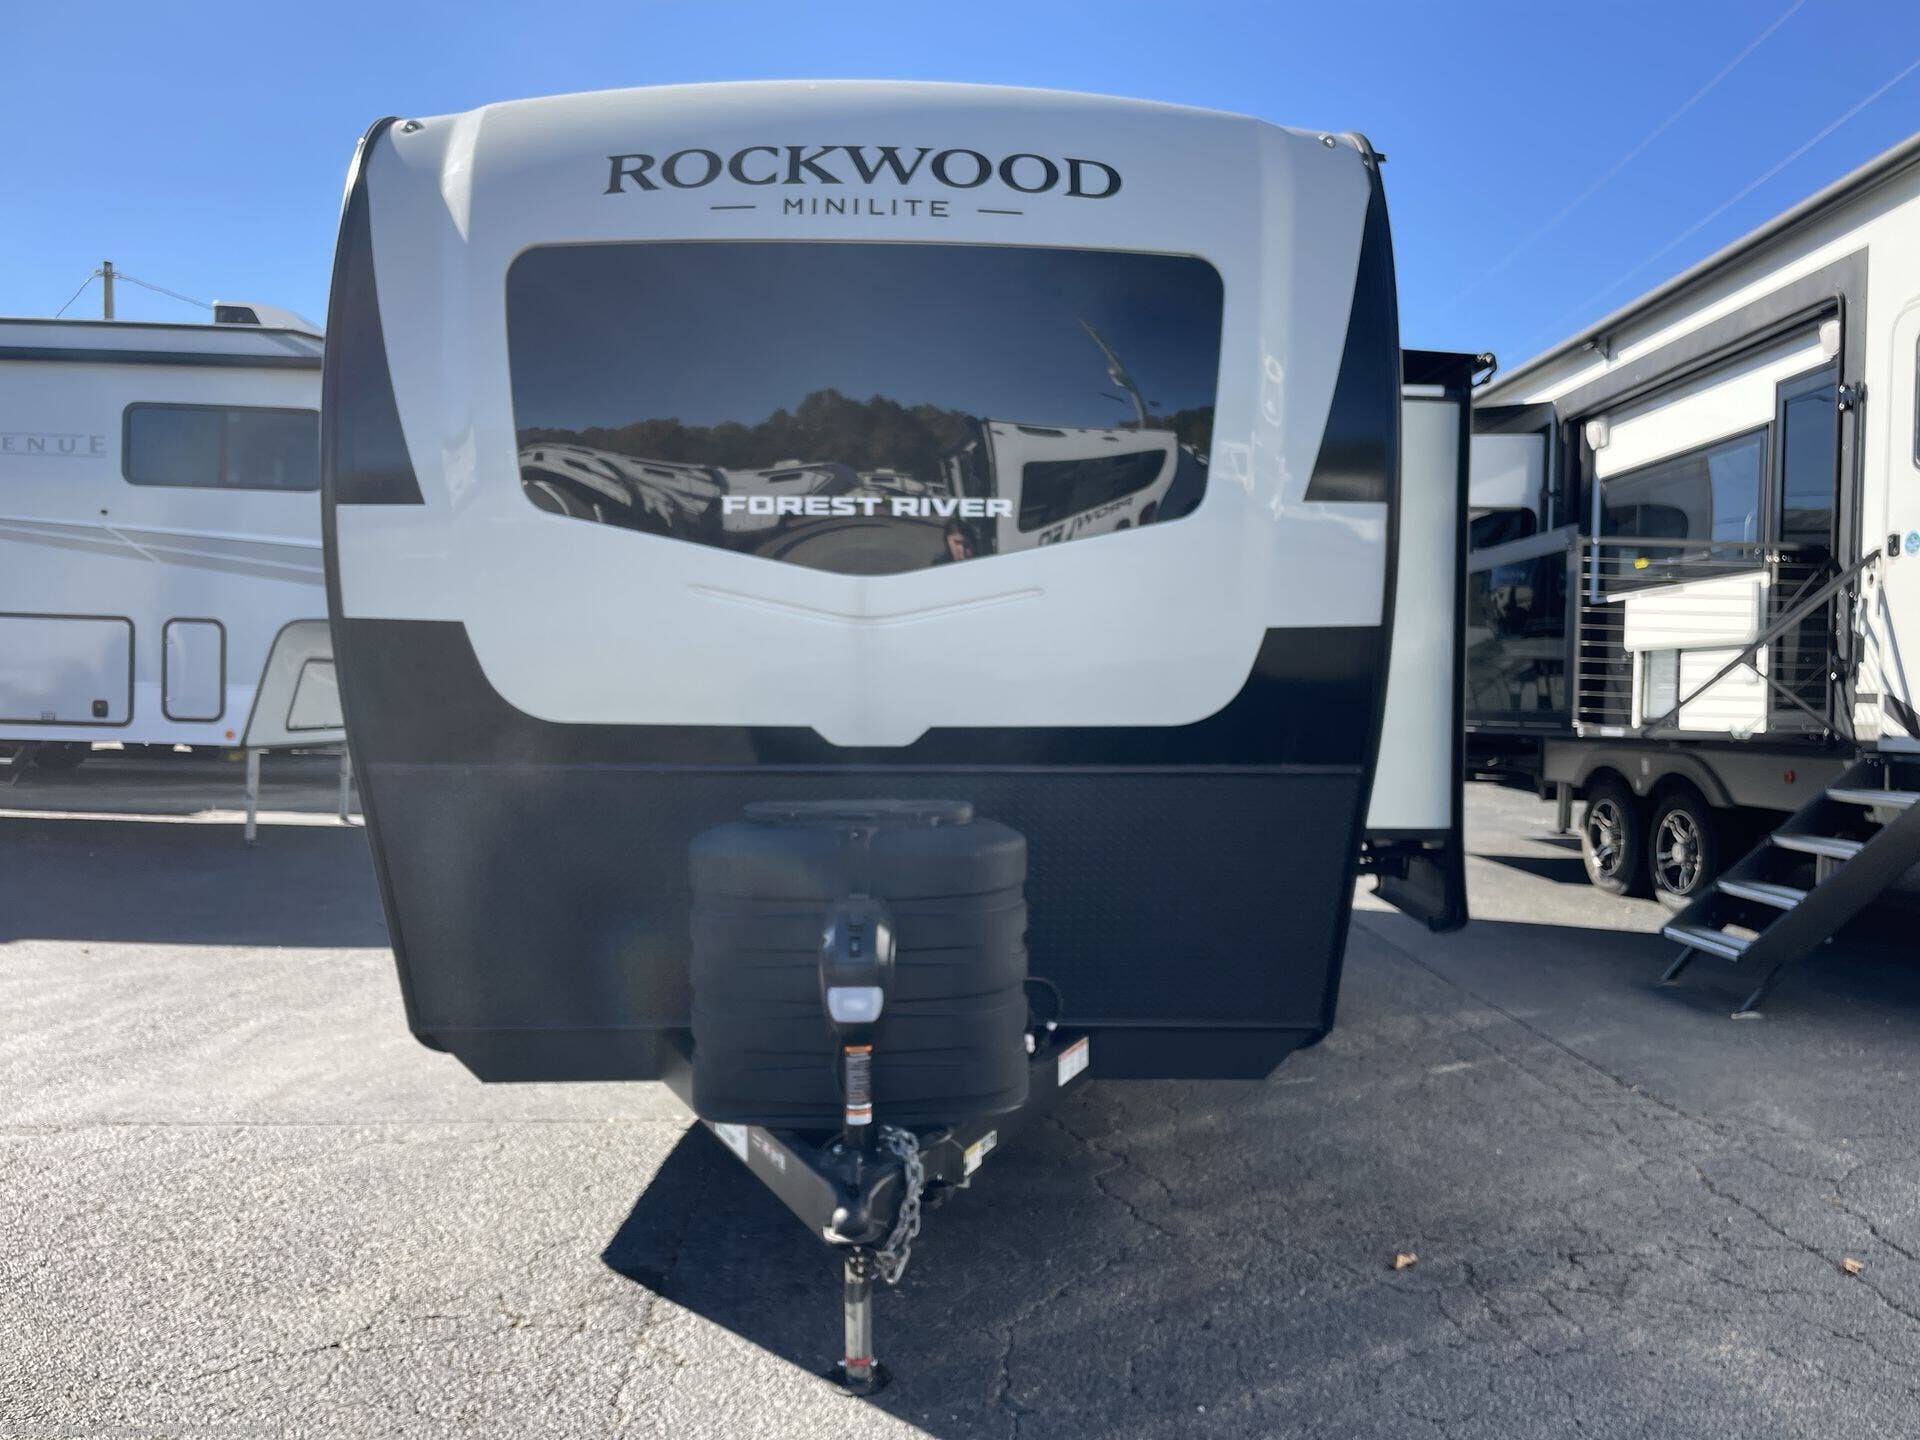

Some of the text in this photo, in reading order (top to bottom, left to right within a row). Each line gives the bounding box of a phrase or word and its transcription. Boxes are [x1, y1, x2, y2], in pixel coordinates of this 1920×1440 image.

[602, 145, 1122, 199] ROCKWOOD
[783, 197, 949, 218] MINILITE
[721, 495, 1013, 519] FOREST RIVER
